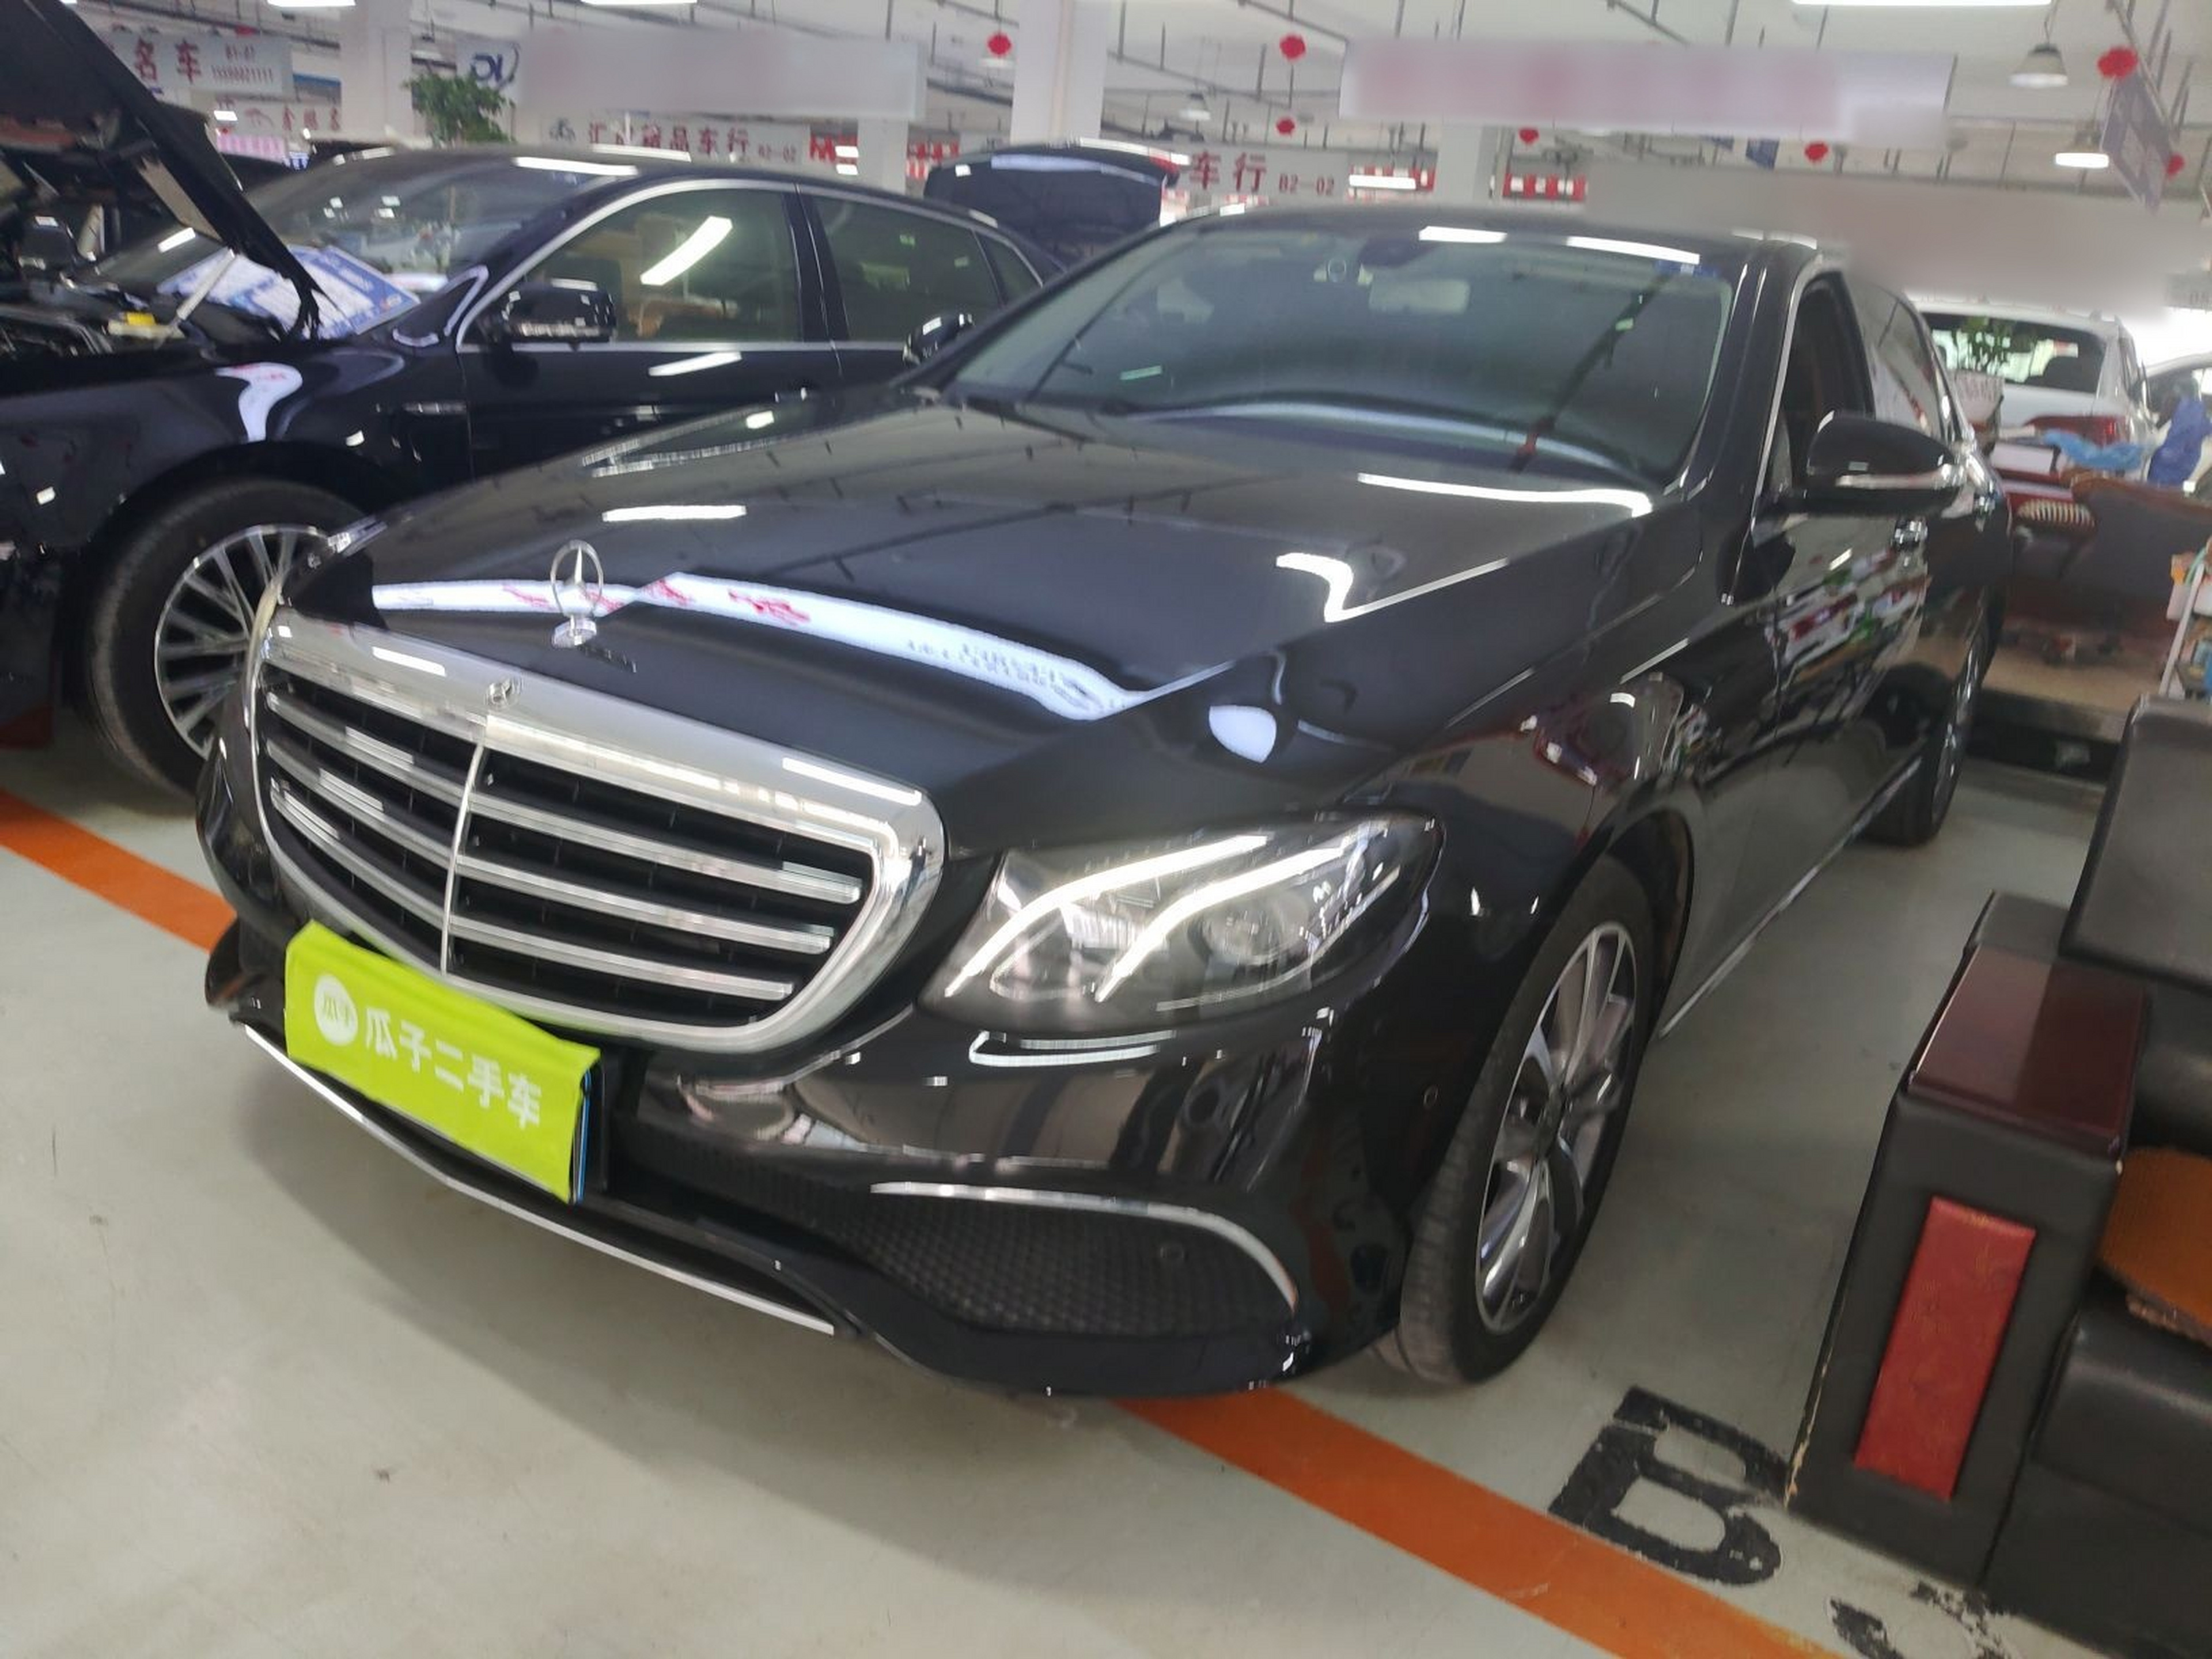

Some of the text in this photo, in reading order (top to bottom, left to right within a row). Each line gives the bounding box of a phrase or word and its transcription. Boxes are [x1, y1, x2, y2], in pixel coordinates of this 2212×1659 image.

[100, 35, 202, 84] 名车
[1190, 151, 1267, 192] 车行
[365, 1007, 542, 1129] 瓜子二手车
